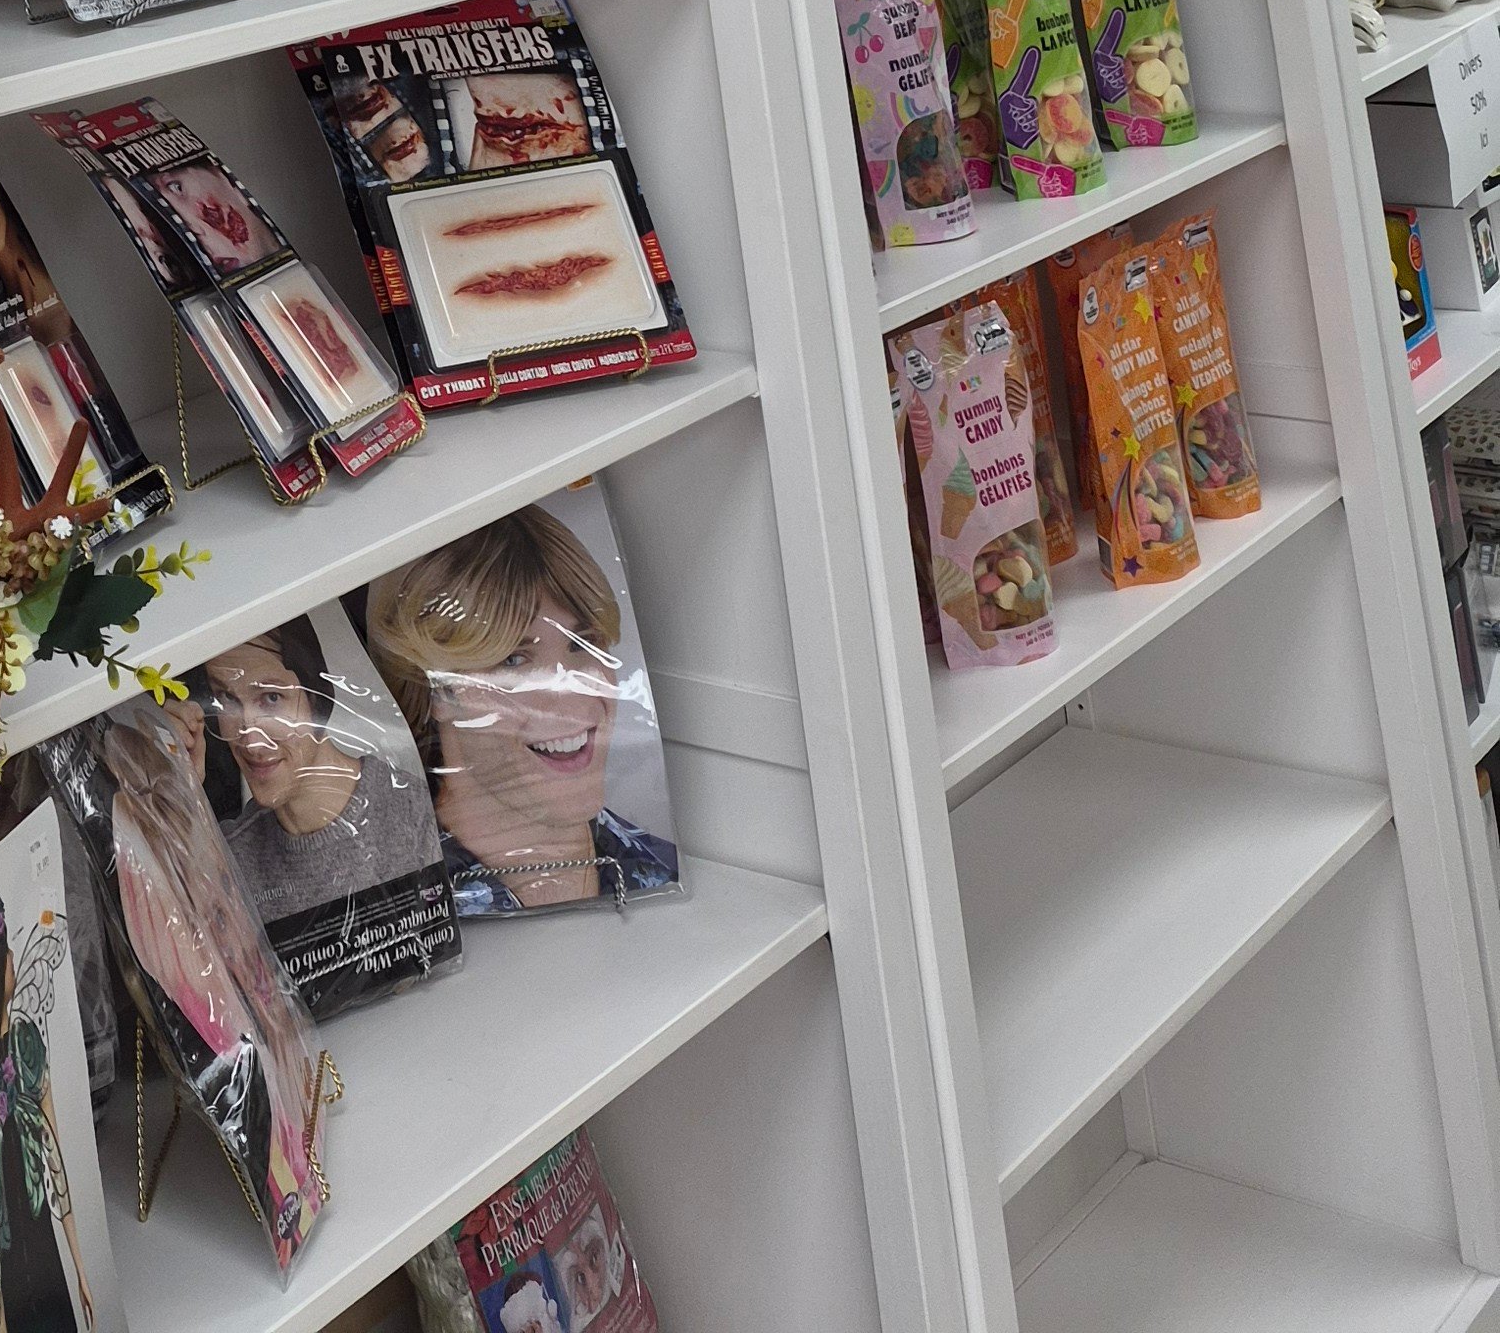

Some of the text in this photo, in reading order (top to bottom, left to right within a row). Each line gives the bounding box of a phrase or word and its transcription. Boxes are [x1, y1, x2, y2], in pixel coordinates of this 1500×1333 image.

[385, 16, 511, 42] HOLLYWOOD FILM QUALITY
[357, 26, 555, 82] FX TRANSFERS
[1040, 35, 1056, 52] LA
[1458, 53, 1483, 81] Divers
[1470, 88, 1488, 115] 50%
[104, 149, 141, 179] FX
[123, 126, 204, 170] TRANSFERS
[1108, 334, 1142, 361] all star
[1137, 346, 1160, 369] MIX
[419, 384, 443, 401] CUT
[442, 376, 488, 396] THROAT
[953, 395, 1004, 429] gummy
[964, 413, 1005, 445] CANDY
[970, 451, 1027, 486] bonbons
[978, 469, 1033, 509] GÉLIFIÉS
[398, 900, 451, 931] Perruque
[353, 921, 397, 949] Coupe
[426, 925, 455, 952] Comb
[364, 950, 394, 974] Wig
[489, 1165, 553, 1234] ENSEMBLE
[480, 1205, 555, 1278] PERRUQUE
[549, 1193, 562, 1225] de
